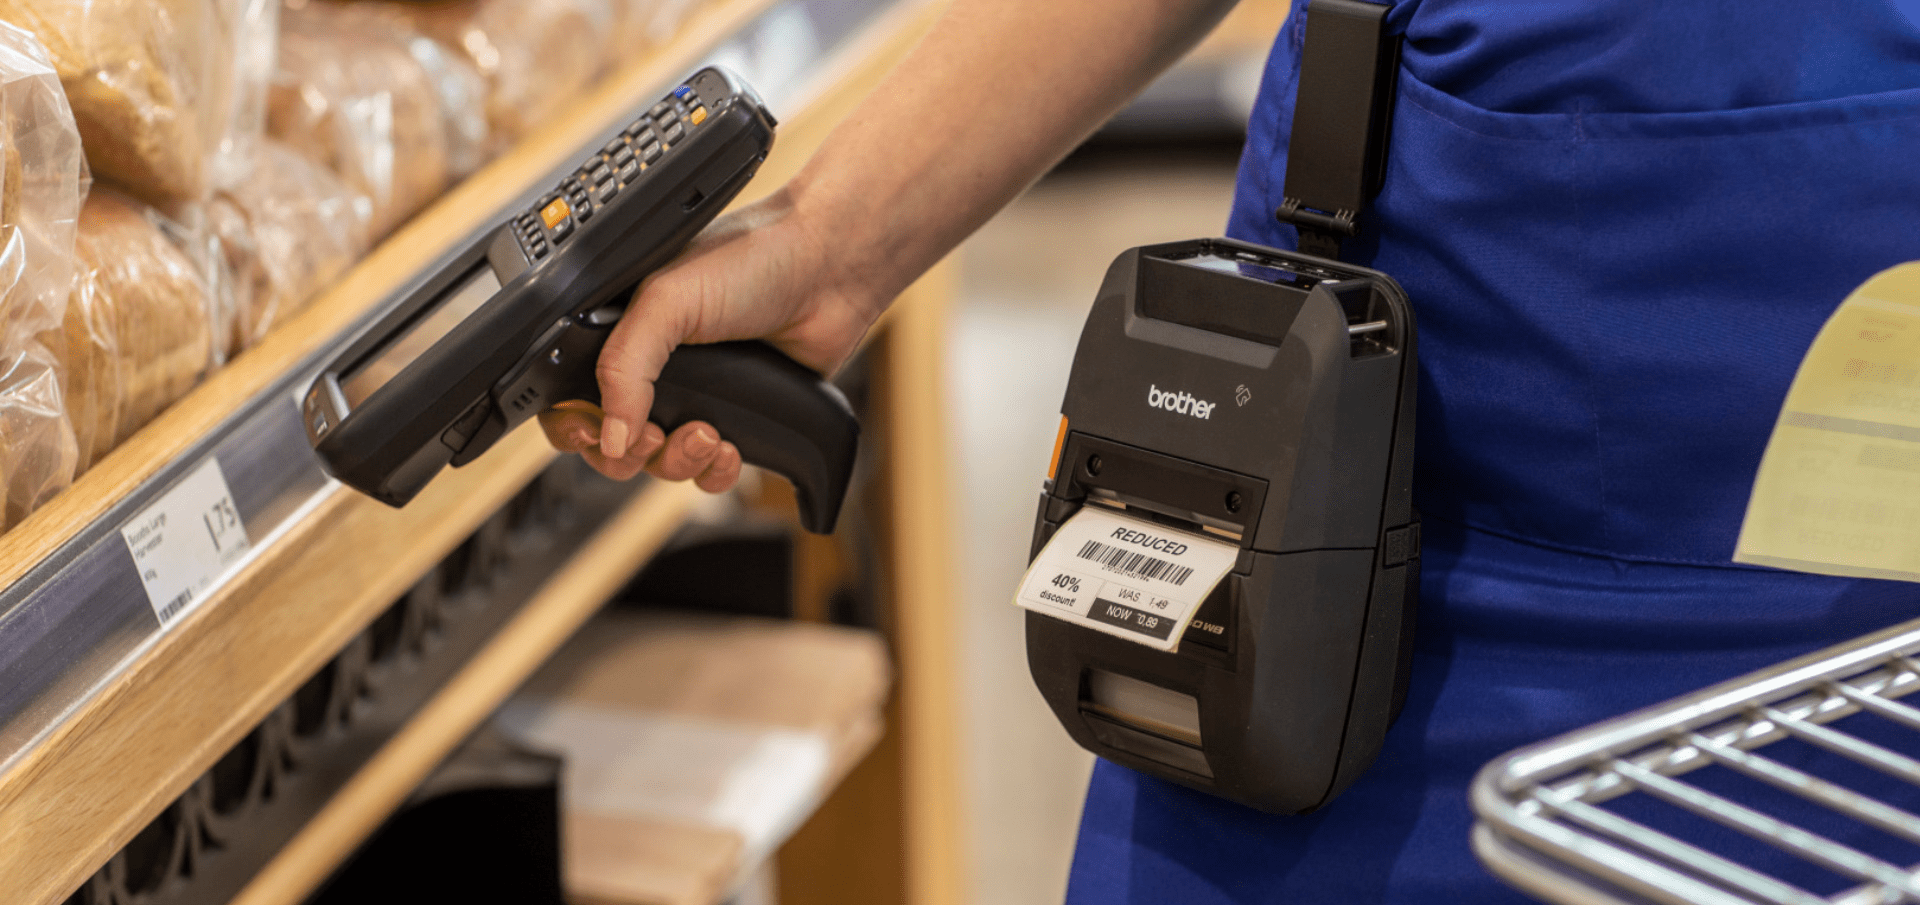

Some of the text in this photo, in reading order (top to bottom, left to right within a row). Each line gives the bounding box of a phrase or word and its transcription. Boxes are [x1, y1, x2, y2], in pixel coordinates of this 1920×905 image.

[1147, 384, 1216, 420] brother
[1110, 526, 1188, 556] REDUCED
[1051, 573, 1081, 593] 40%
[1118, 588, 1141, 602] WAS
[1106, 604, 1133, 620] NOW
